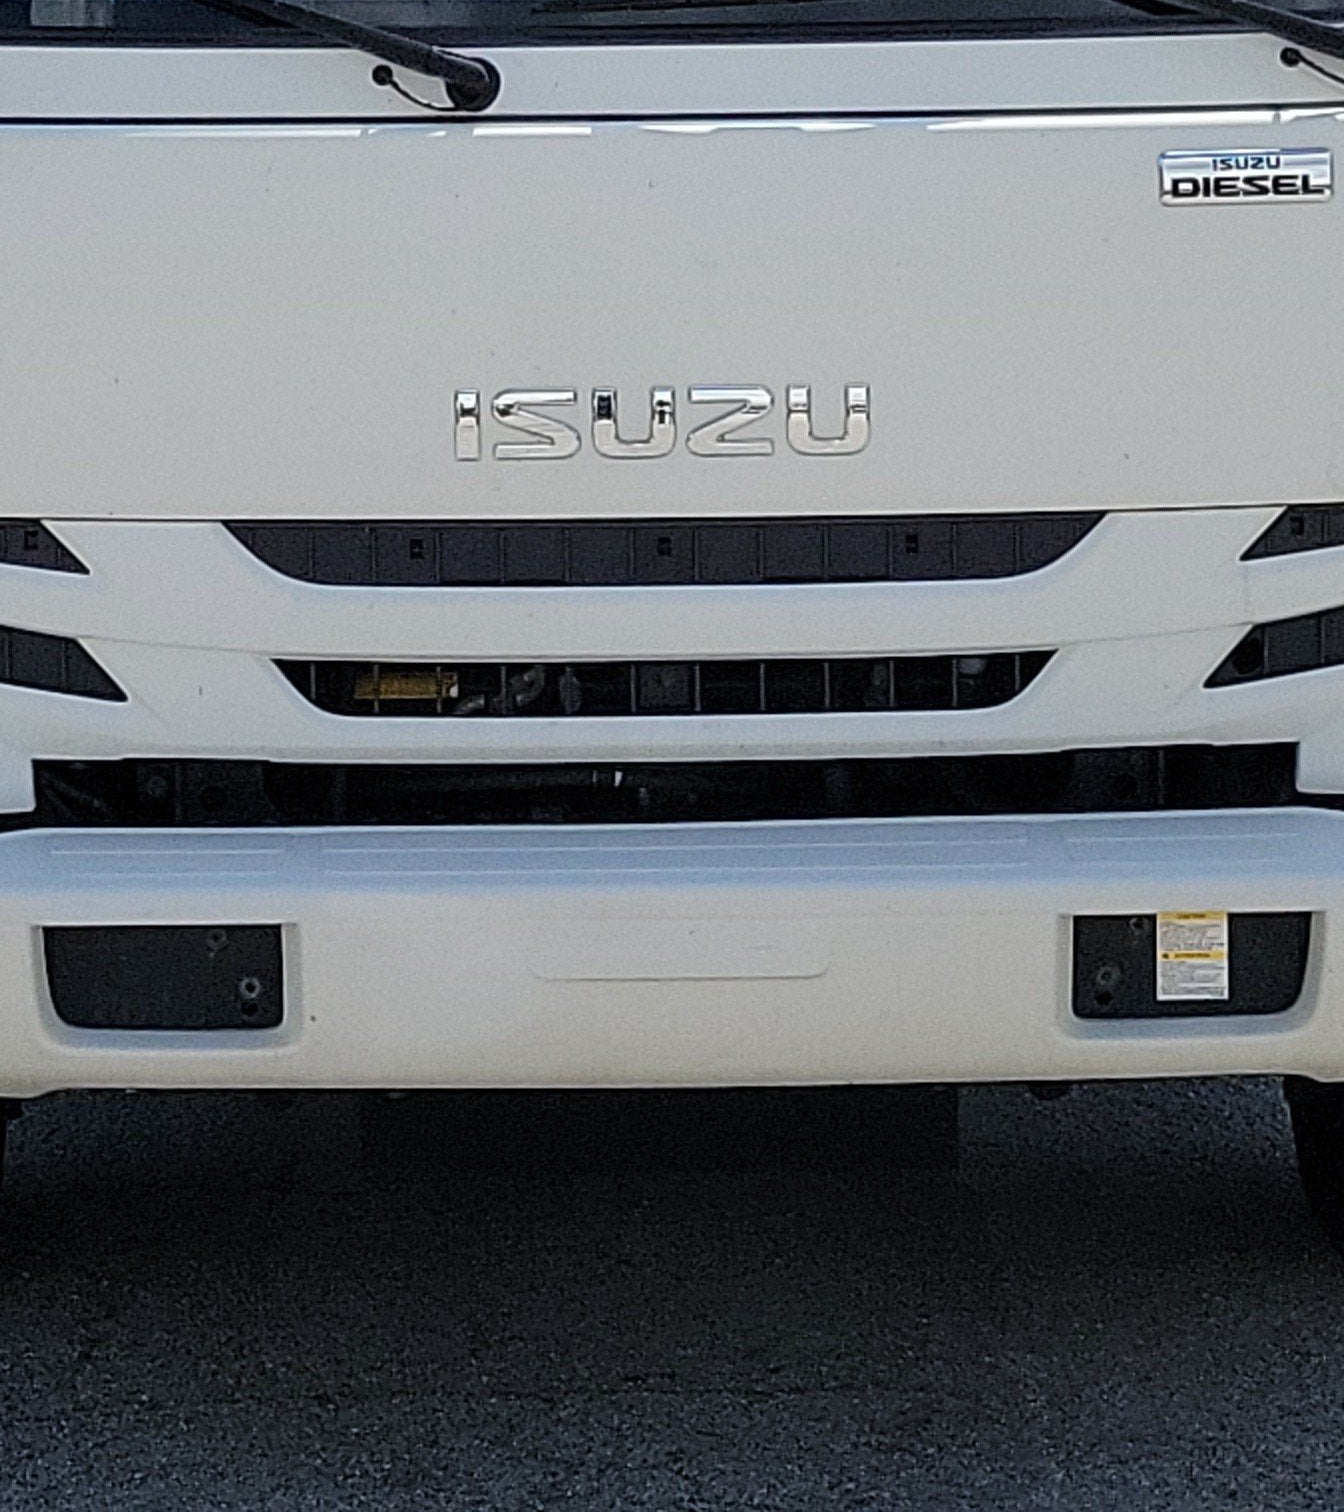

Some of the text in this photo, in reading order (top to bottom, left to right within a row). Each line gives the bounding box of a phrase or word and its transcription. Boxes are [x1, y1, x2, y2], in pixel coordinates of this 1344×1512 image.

[1211, 155, 1282, 172] ISUZU
[1170, 173, 1326, 199] DIESEL
[454, 384, 872, 462] ISUZU
